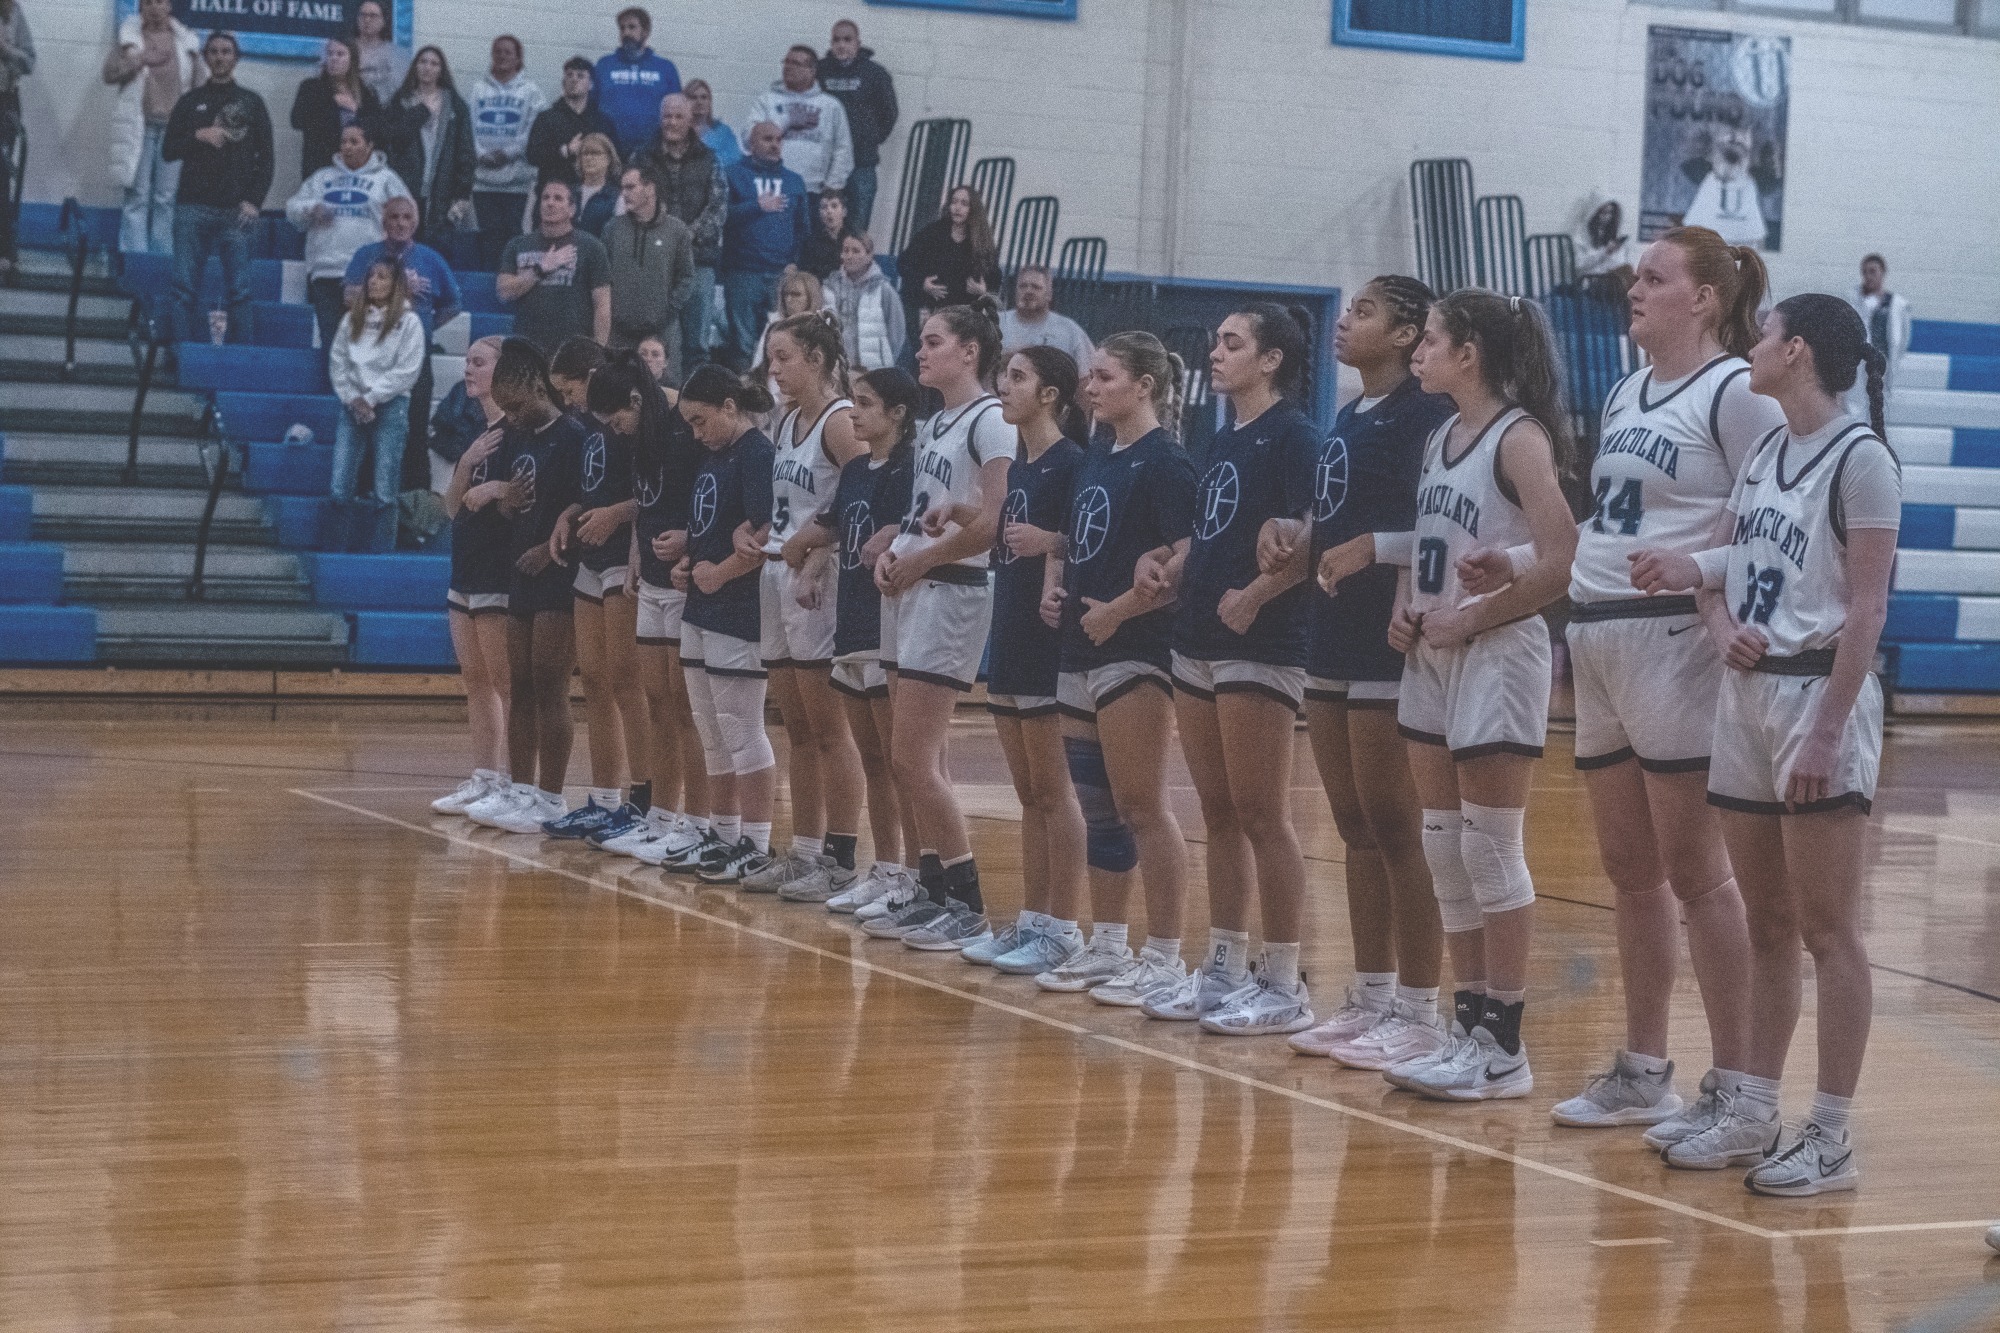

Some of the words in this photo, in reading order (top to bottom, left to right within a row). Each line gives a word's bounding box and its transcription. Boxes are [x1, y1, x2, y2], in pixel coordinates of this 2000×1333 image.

[190, 0, 248, 14] HALL
[252, 0, 283, 16] OF
[287, 0, 344, 22] FAME
[772, 496, 790, 536] 5
